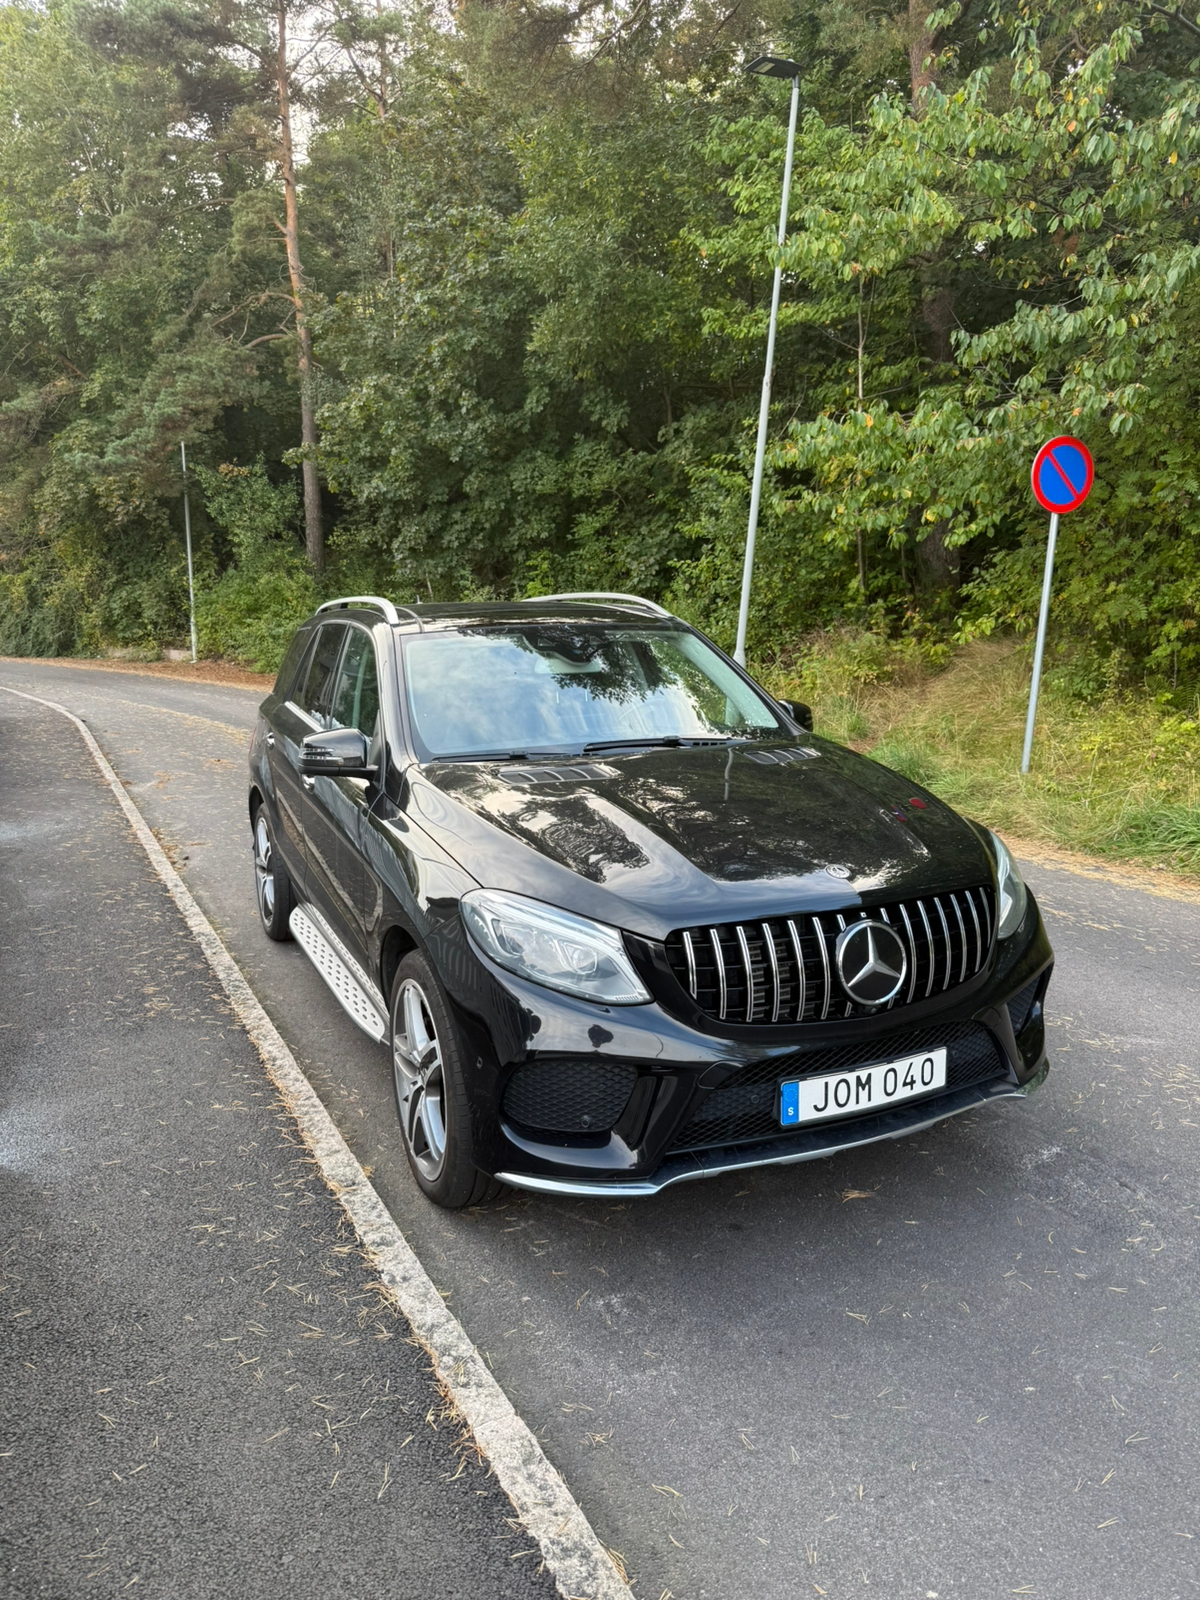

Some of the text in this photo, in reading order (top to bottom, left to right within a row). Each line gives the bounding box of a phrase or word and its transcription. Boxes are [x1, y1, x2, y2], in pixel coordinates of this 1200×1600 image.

[813, 1057, 934, 1112] JOM 040
[787, 1107, 794, 1116] S
